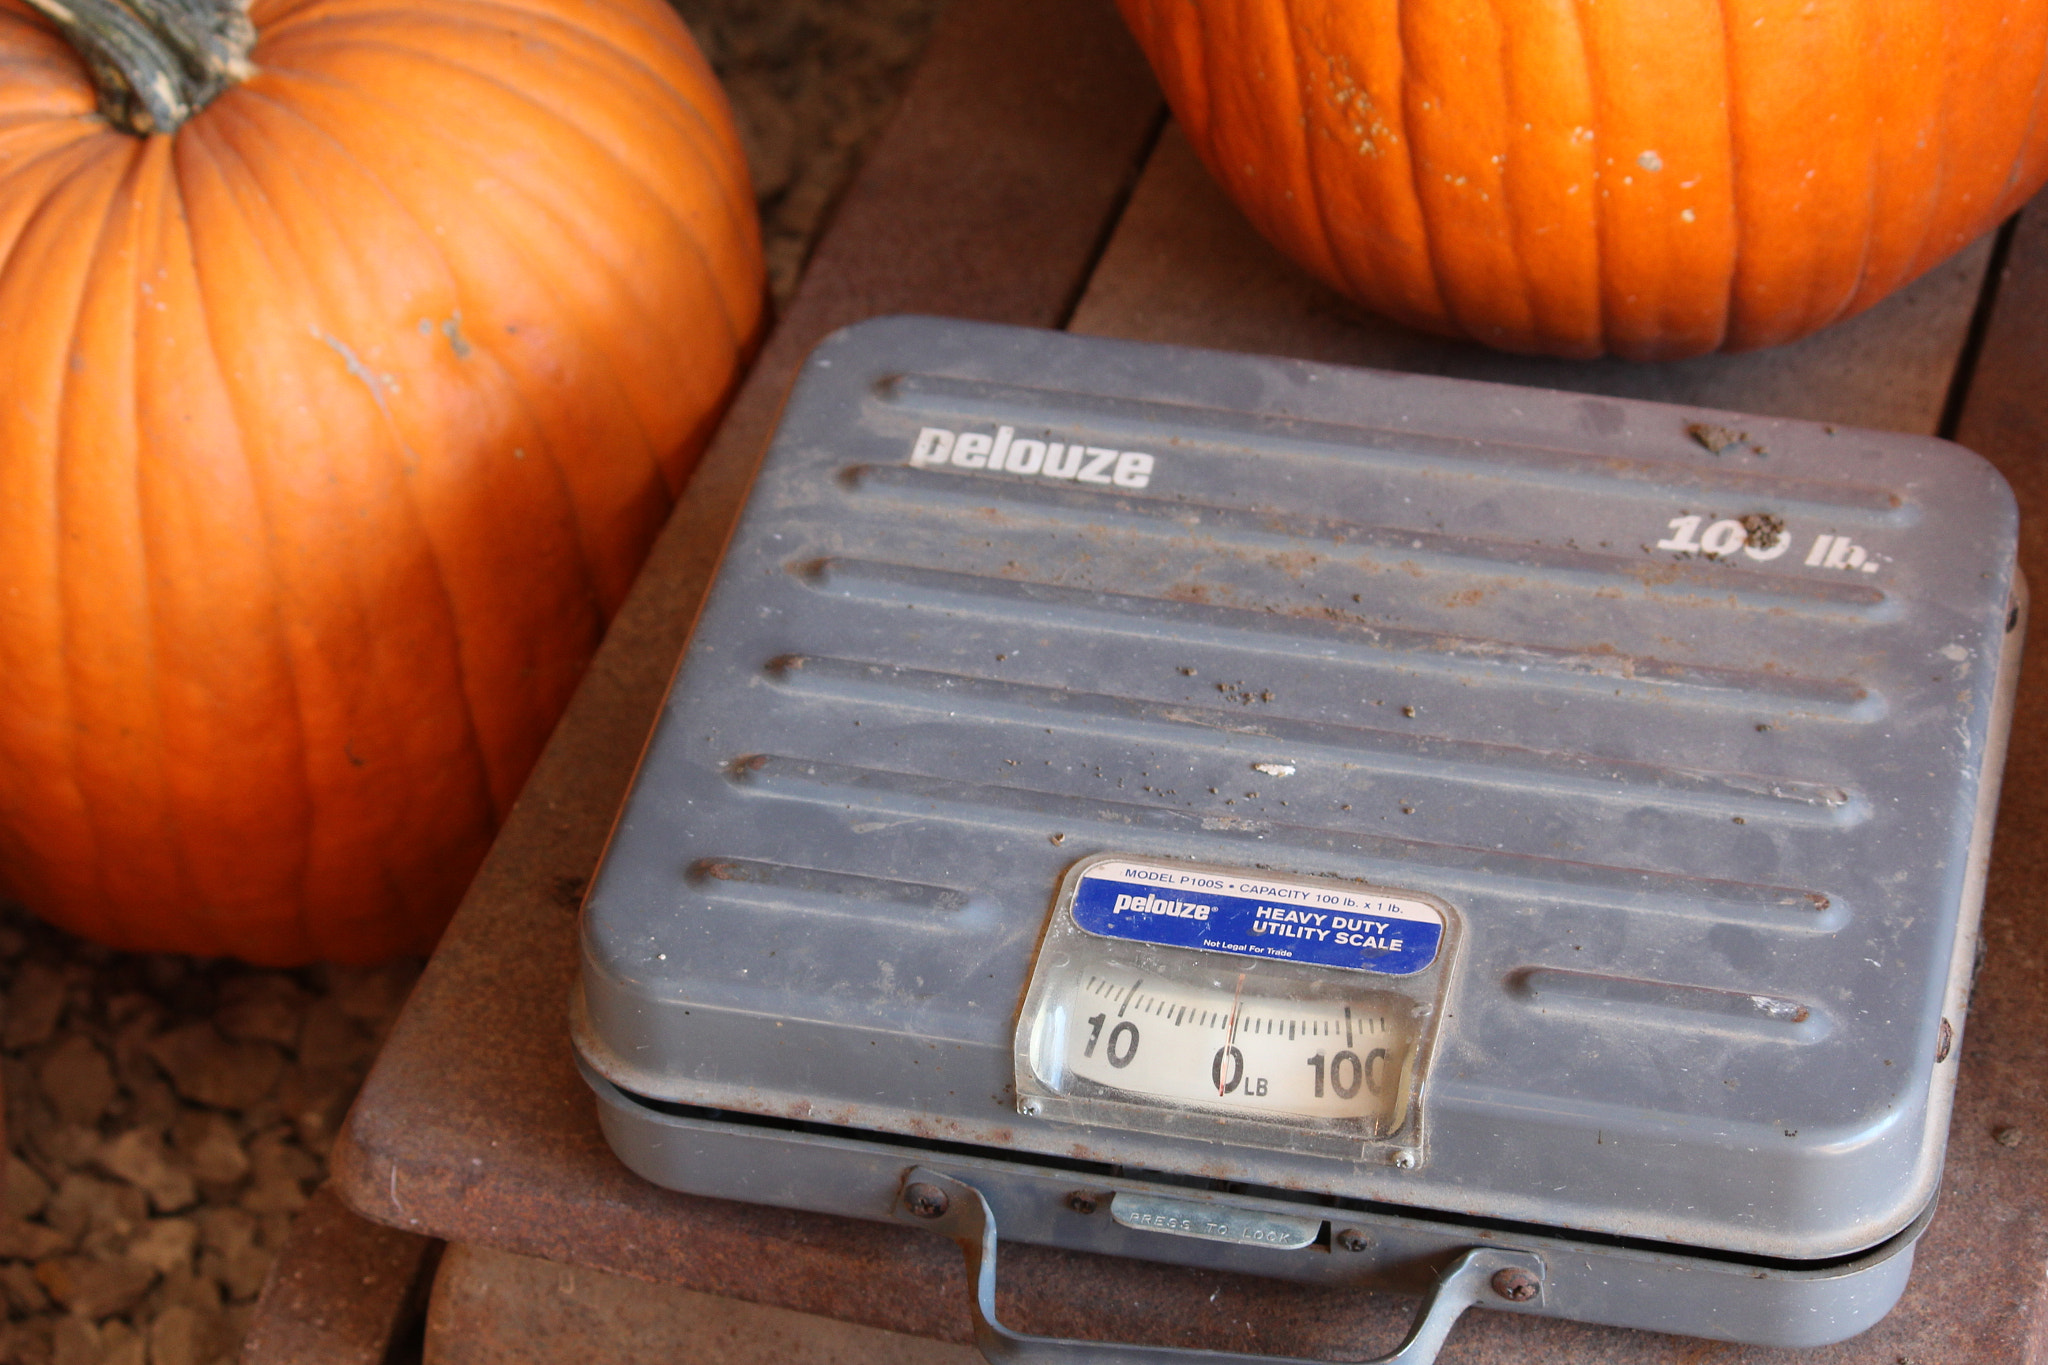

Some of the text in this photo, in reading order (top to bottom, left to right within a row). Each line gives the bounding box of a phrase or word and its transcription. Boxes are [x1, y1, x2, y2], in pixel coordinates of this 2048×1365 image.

[908, 425, 1155, 489] pelouze
[1804, 534, 1880, 574] lb.
[1125, 868, 1176, 884] MODEL
[1180, 876, 1224, 890] P100S
[1239, 883, 1310, 901] CAPACITY
[1315, 894, 1339, 905] 100
[1343, 898, 1359, 908] lb.
[1388, 903, 1404, 914] lb.
[1252, 920, 1404, 952] UTILITY SCALE
[1255, 906, 1389, 935] HEAVY DUTY
[1203, 939, 1293, 958] Not Legal For Trade
[1083, 1013, 1140, 1069] 10
[1129, 1212, 1291, 1244] PRESS TO LOCK
